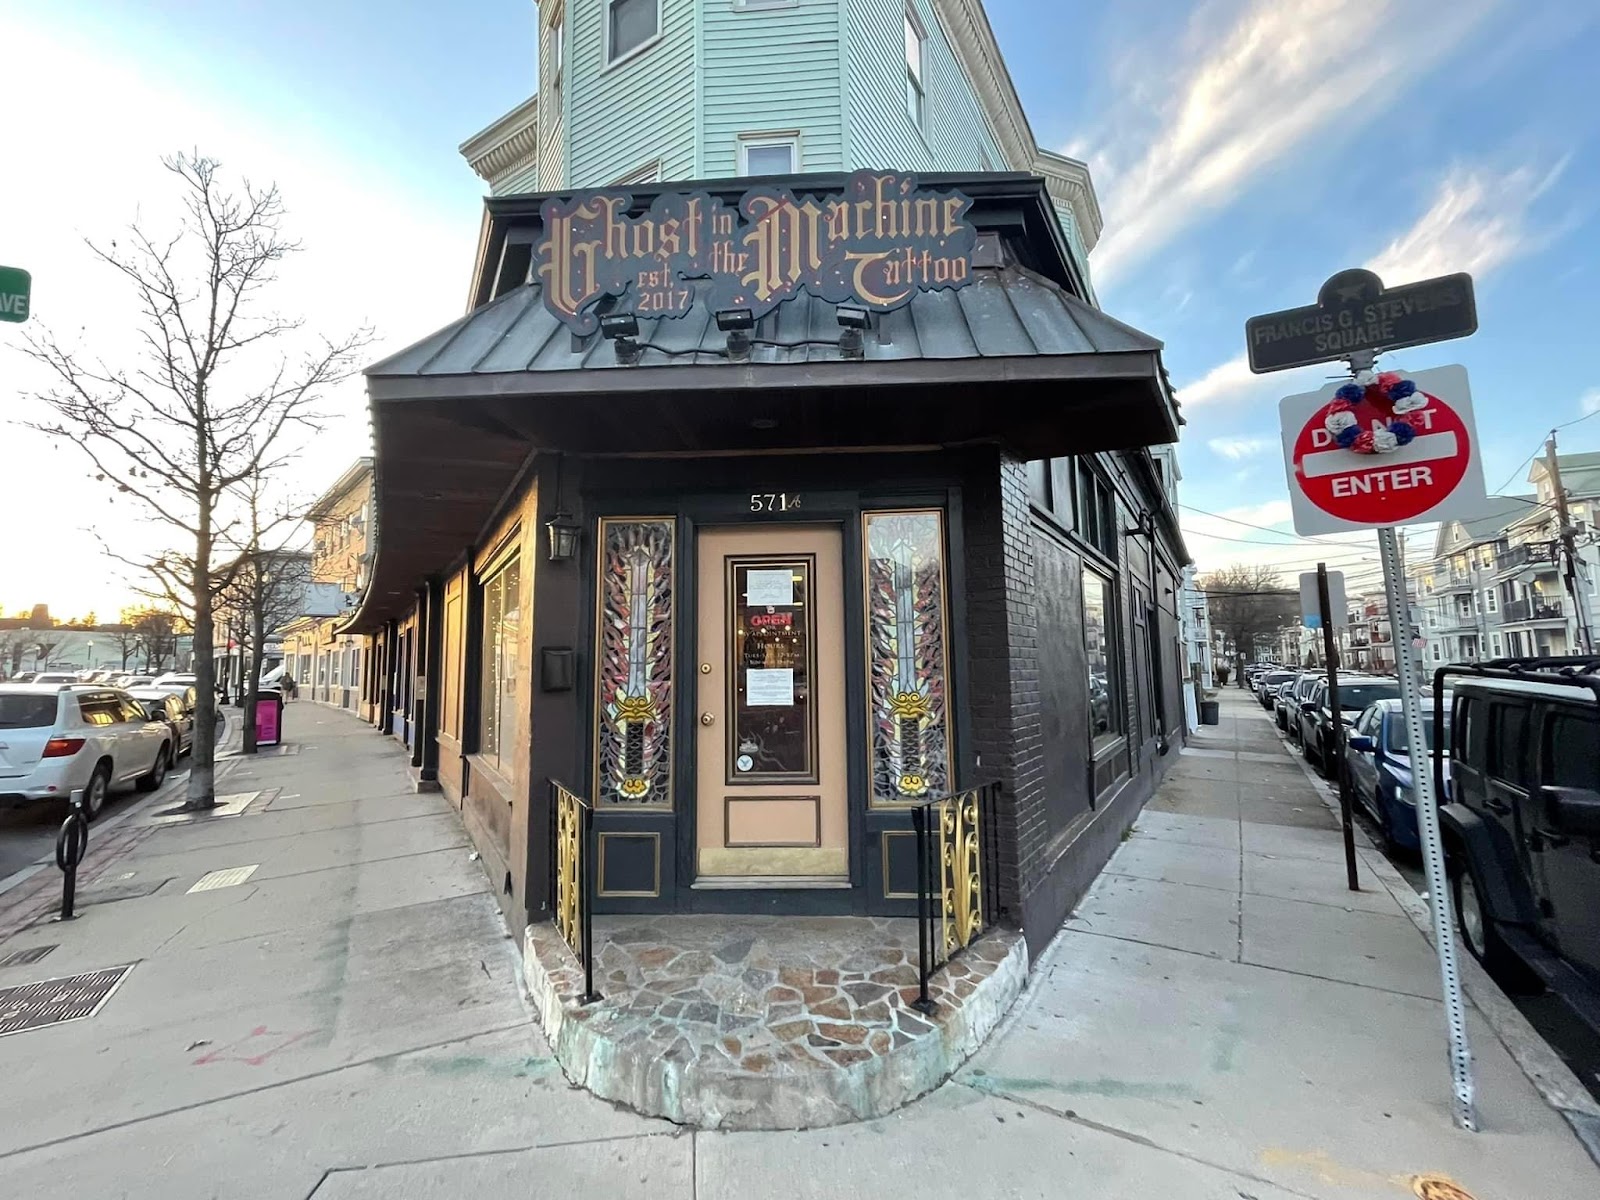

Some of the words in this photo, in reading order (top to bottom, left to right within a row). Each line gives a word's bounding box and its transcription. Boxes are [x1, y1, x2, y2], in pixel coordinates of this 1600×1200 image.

[712, 205, 732, 236] in
[740, 175, 972, 302] Machine
[538, 195, 704, 315] Ghost
[710, 240, 749, 275] the
[844, 247, 968, 306] Tattoo
[0, 292, 26, 315] VE
[637, 290, 690, 312] 2017
[1254, 313, 1334, 345] FRANCIS
[1338, 309, 1361, 328] G.
[1314, 321, 1396, 352] SQUARE
[1371, 408, 1437, 434] NT
[1331, 466, 1434, 498] ENTER
